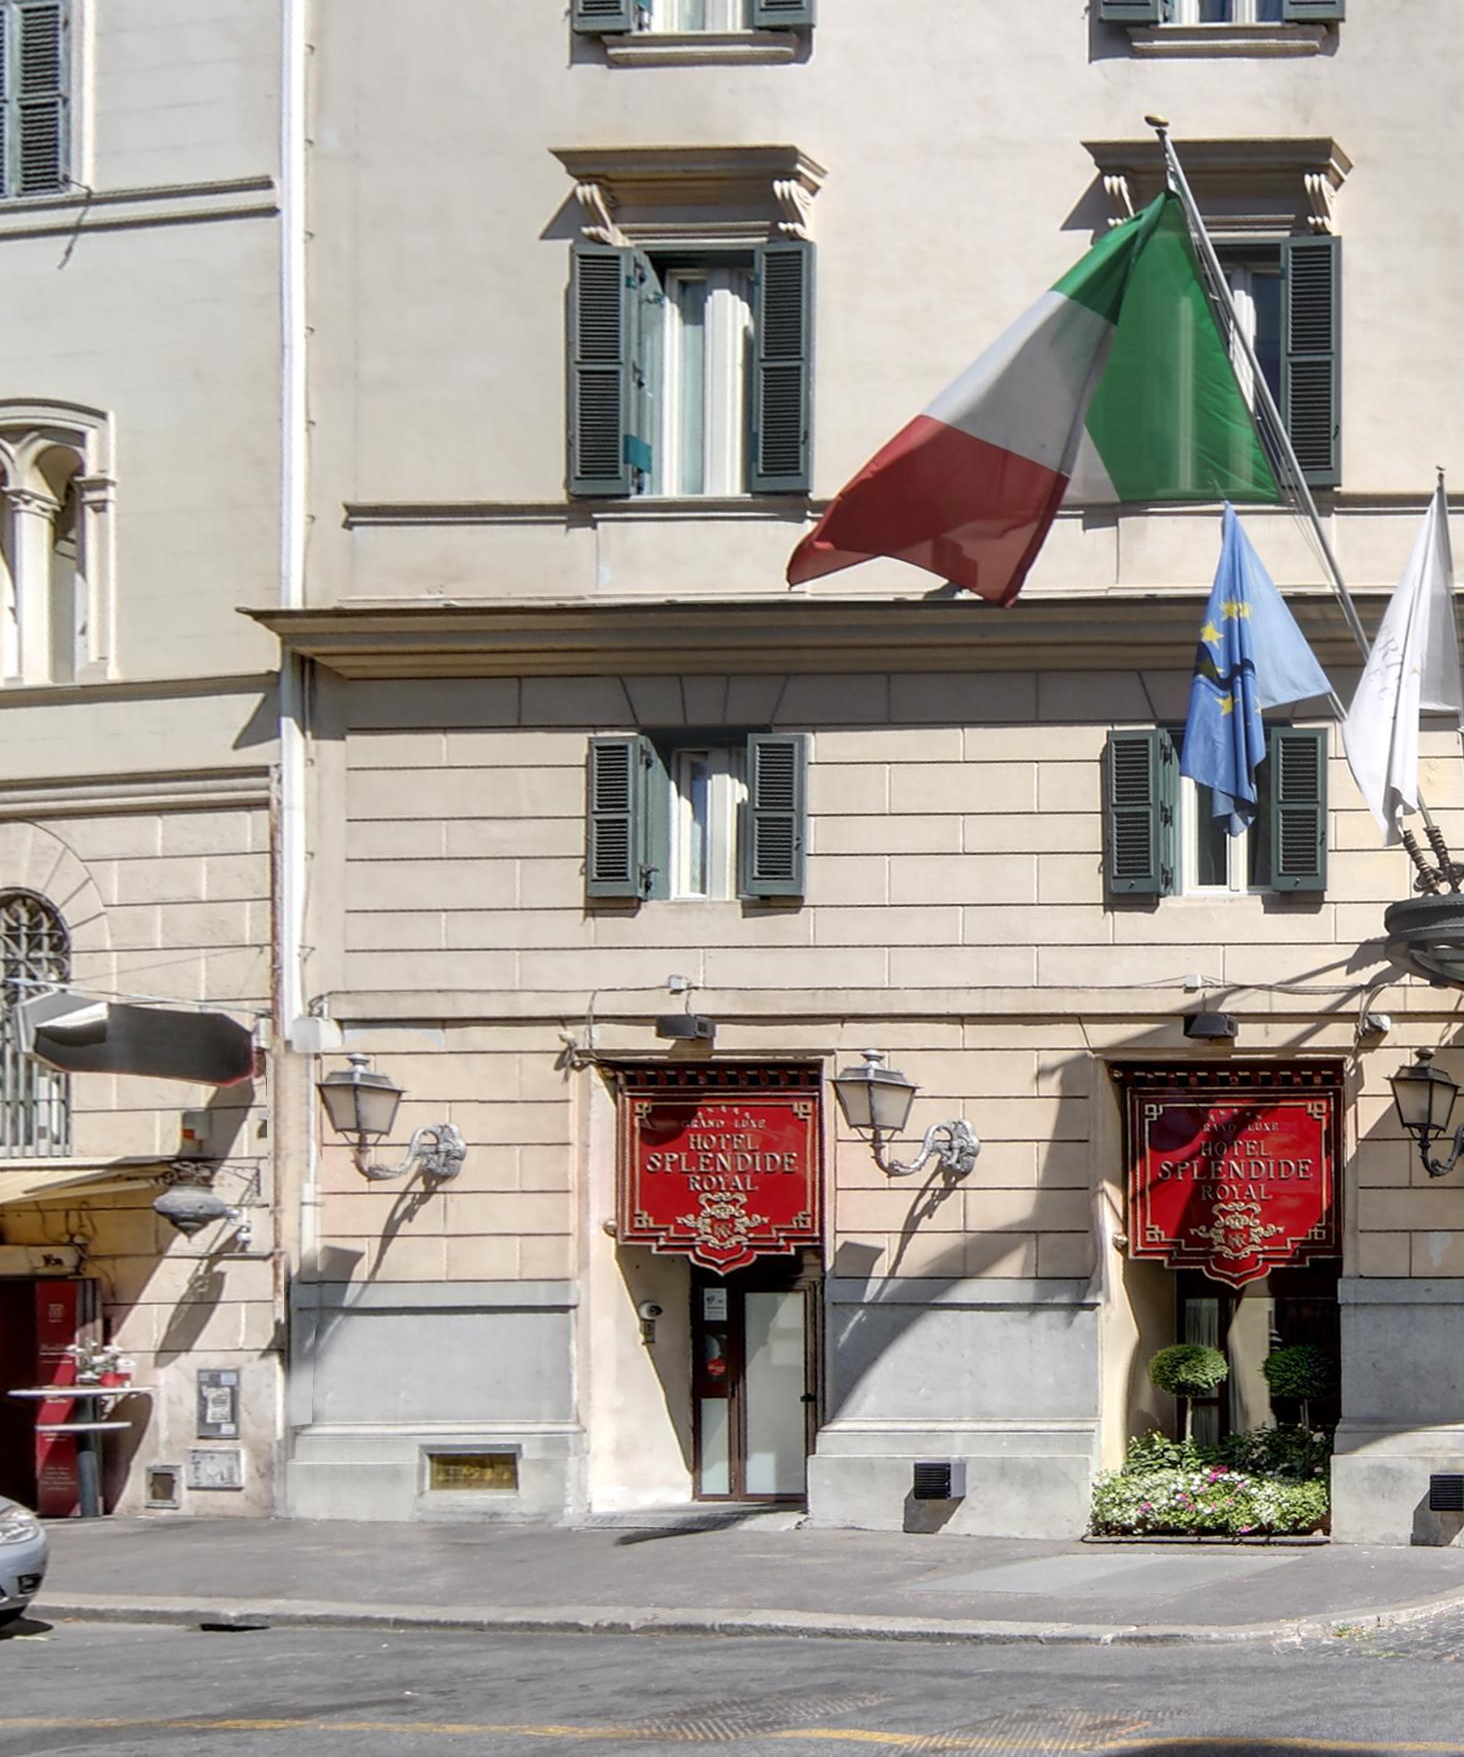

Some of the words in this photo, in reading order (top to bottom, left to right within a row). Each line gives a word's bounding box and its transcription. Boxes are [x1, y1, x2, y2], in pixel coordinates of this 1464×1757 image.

[733, 1118, 767, 1130] LUXE
[1247, 1121, 1280, 1132] LUXE
[688, 1133, 760, 1152] HOTEL
[1199, 1140, 1273, 1158] HOTEL
[645, 1152, 799, 1174] SPLENDIDE
[1157, 1158, 1314, 1181] SPLENDIDE
[687, 1174, 759, 1192] ROYAL
[1200, 1183, 1274, 1202] ROYAL
